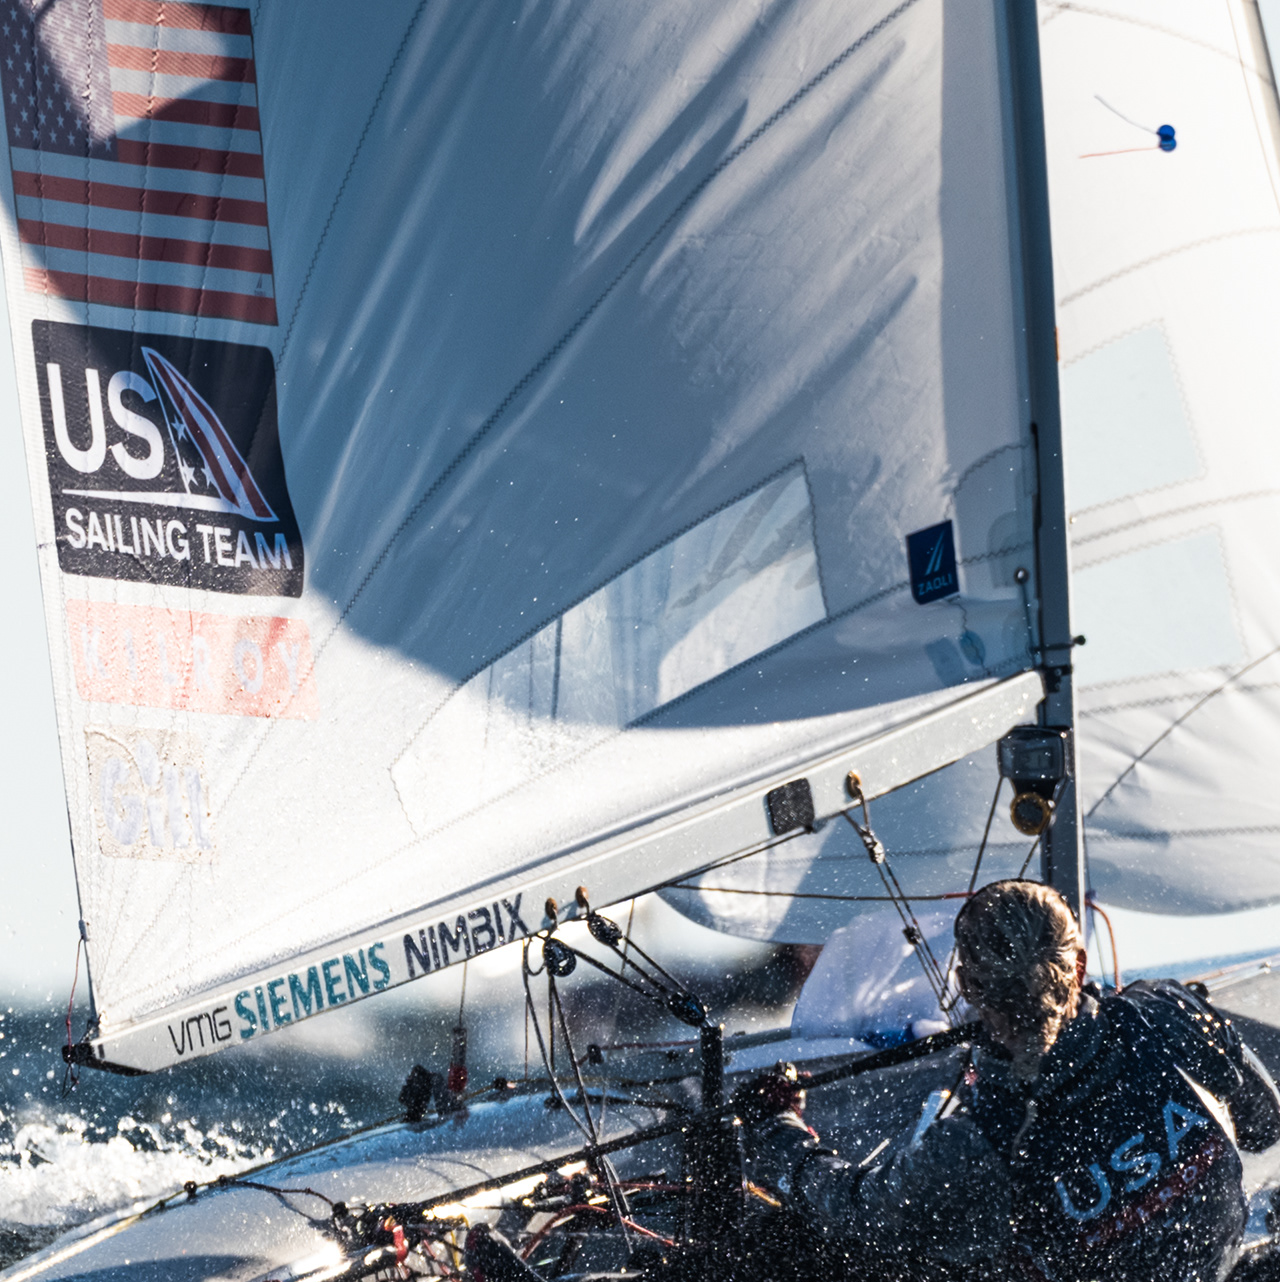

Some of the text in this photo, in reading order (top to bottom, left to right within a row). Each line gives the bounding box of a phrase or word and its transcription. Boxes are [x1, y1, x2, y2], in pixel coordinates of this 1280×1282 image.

[46, 362, 165, 480] US
[65, 507, 293, 571] SAILING TEAM
[918, 573, 953, 596] ZAOLI
[80, 623, 301, 696] KILROY
[234, 942, 391, 1040] SIEMENS
[403, 892, 529, 979] NIMBIX
[1054, 1100, 1210, 1221] USA
